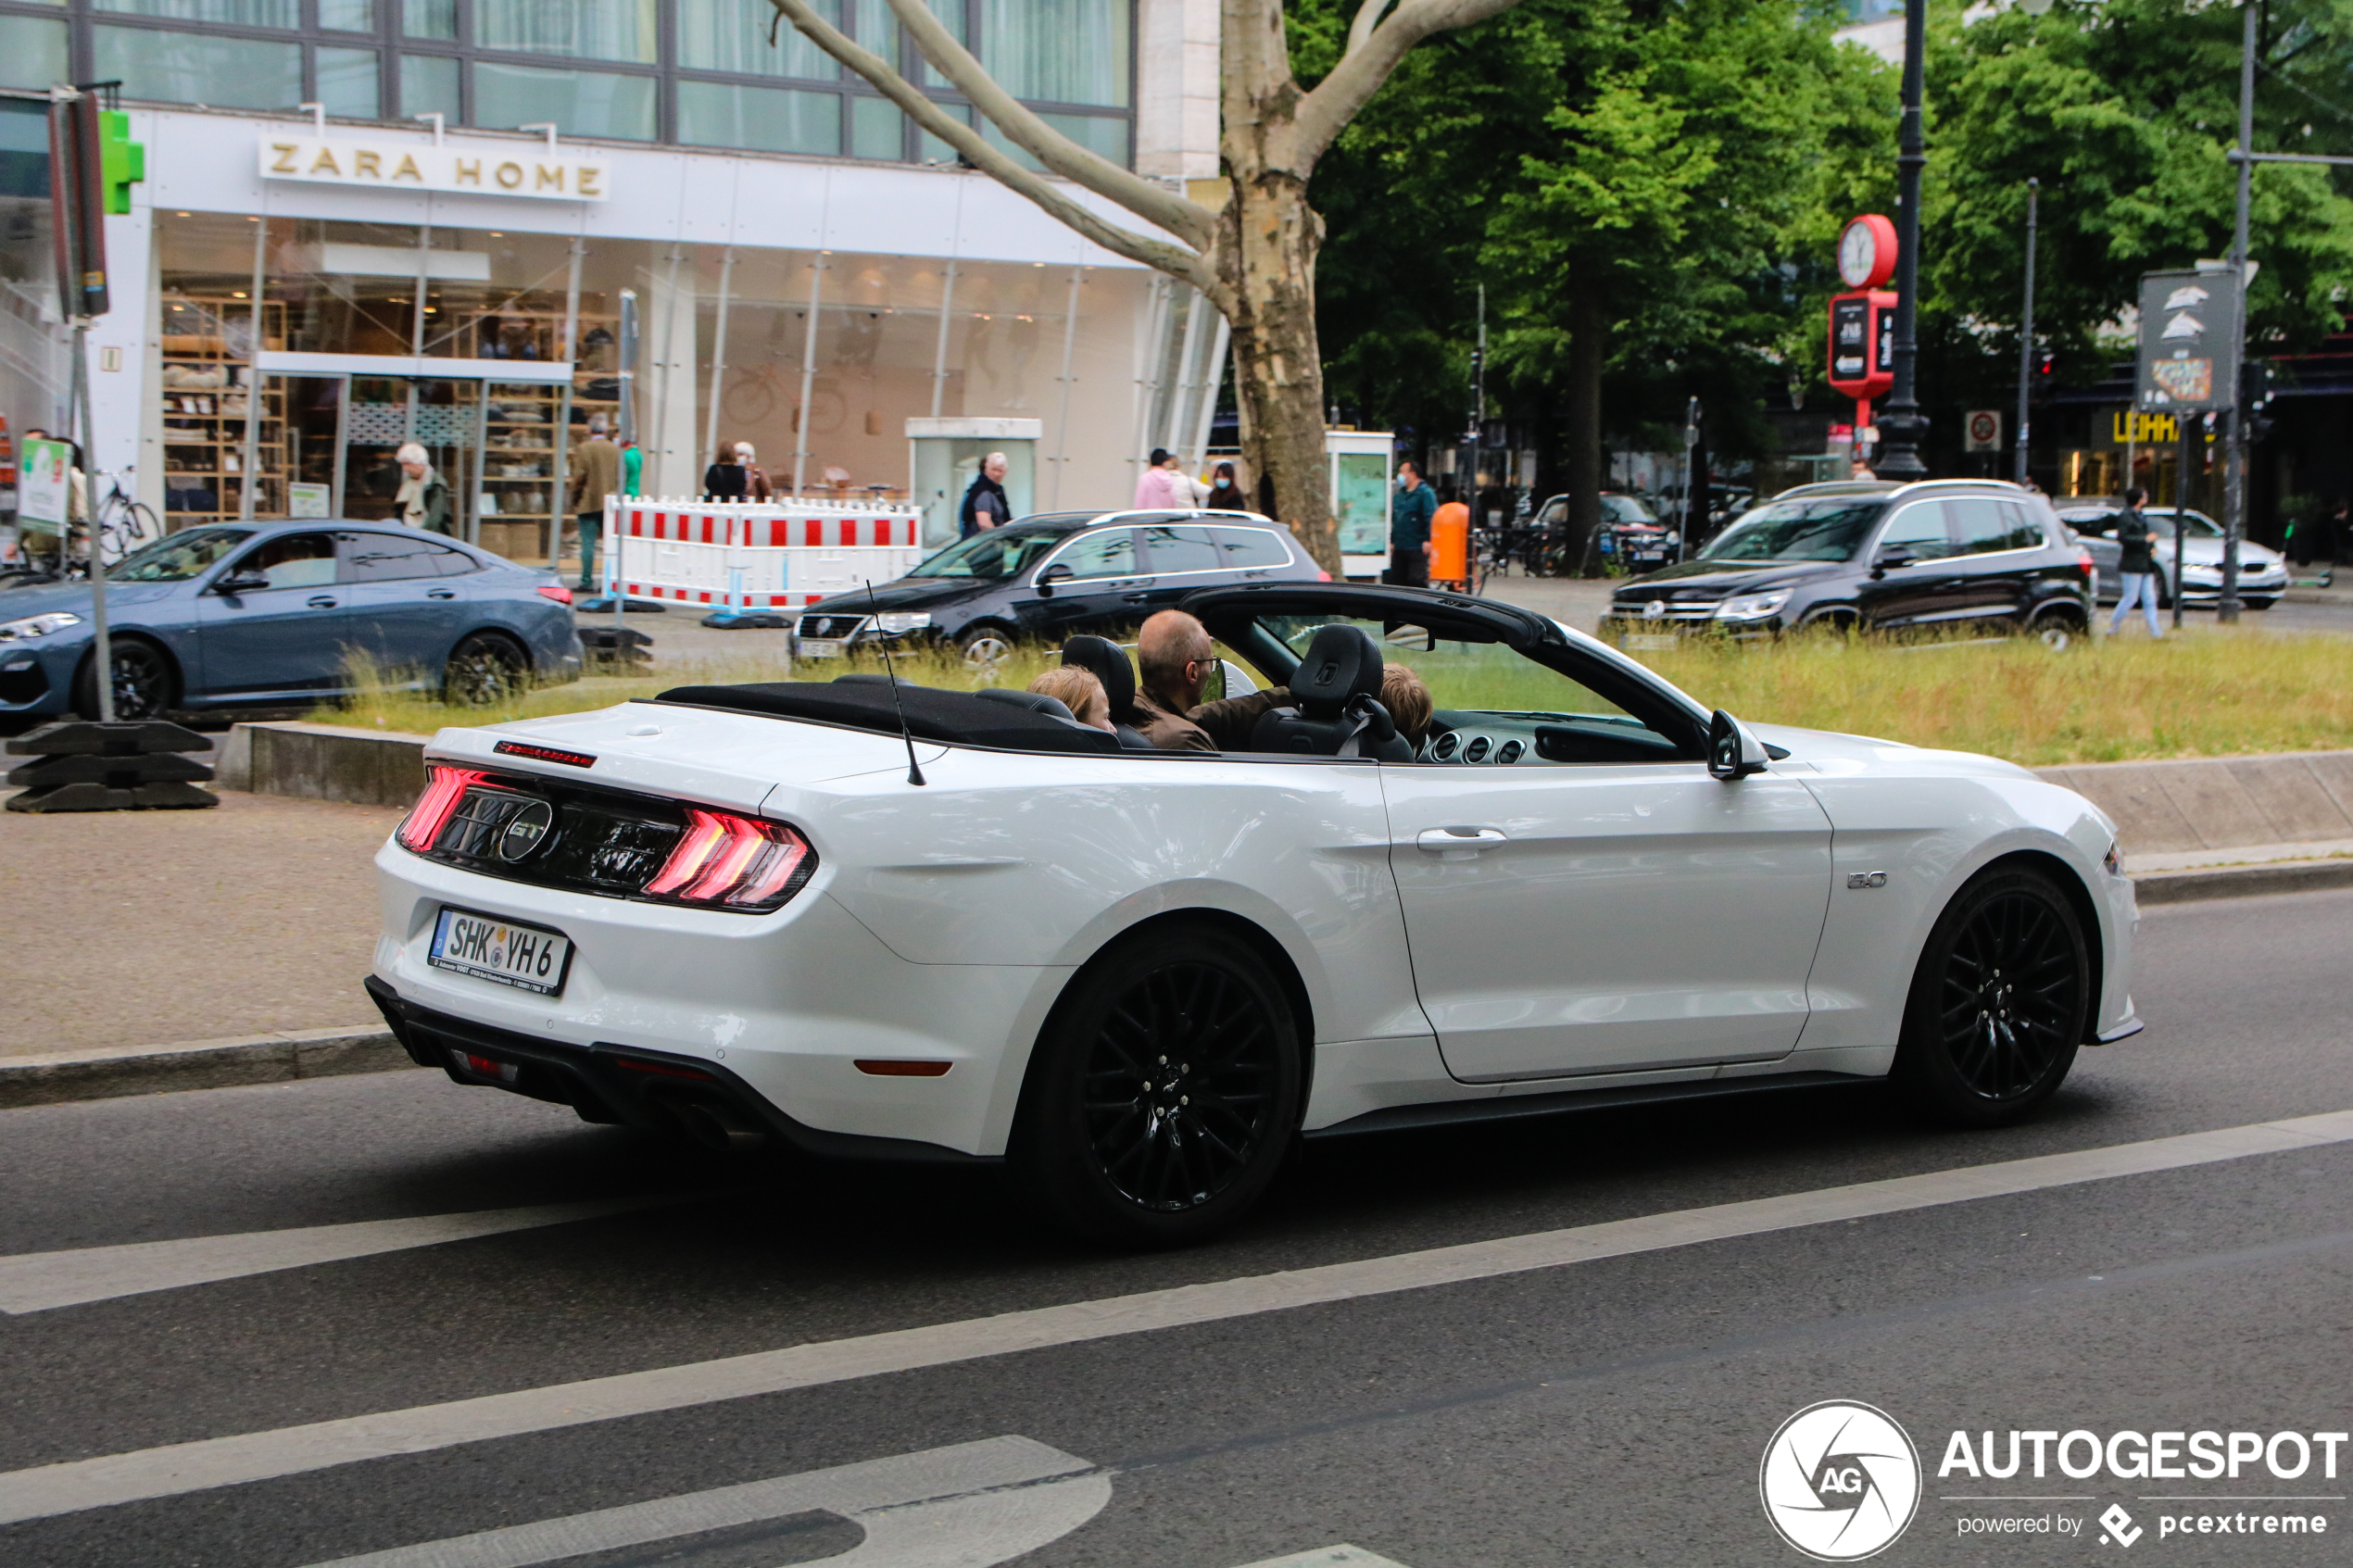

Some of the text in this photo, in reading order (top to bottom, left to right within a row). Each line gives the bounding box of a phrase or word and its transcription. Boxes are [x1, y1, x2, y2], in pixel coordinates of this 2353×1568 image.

[271, 144, 601, 194] ZARA HOME
[509, 822, 545, 839] GT
[1847, 871, 1887, 889] 5.0
[436, 938, 442, 948] D
[450, 918, 553, 977] SHK YH 6
